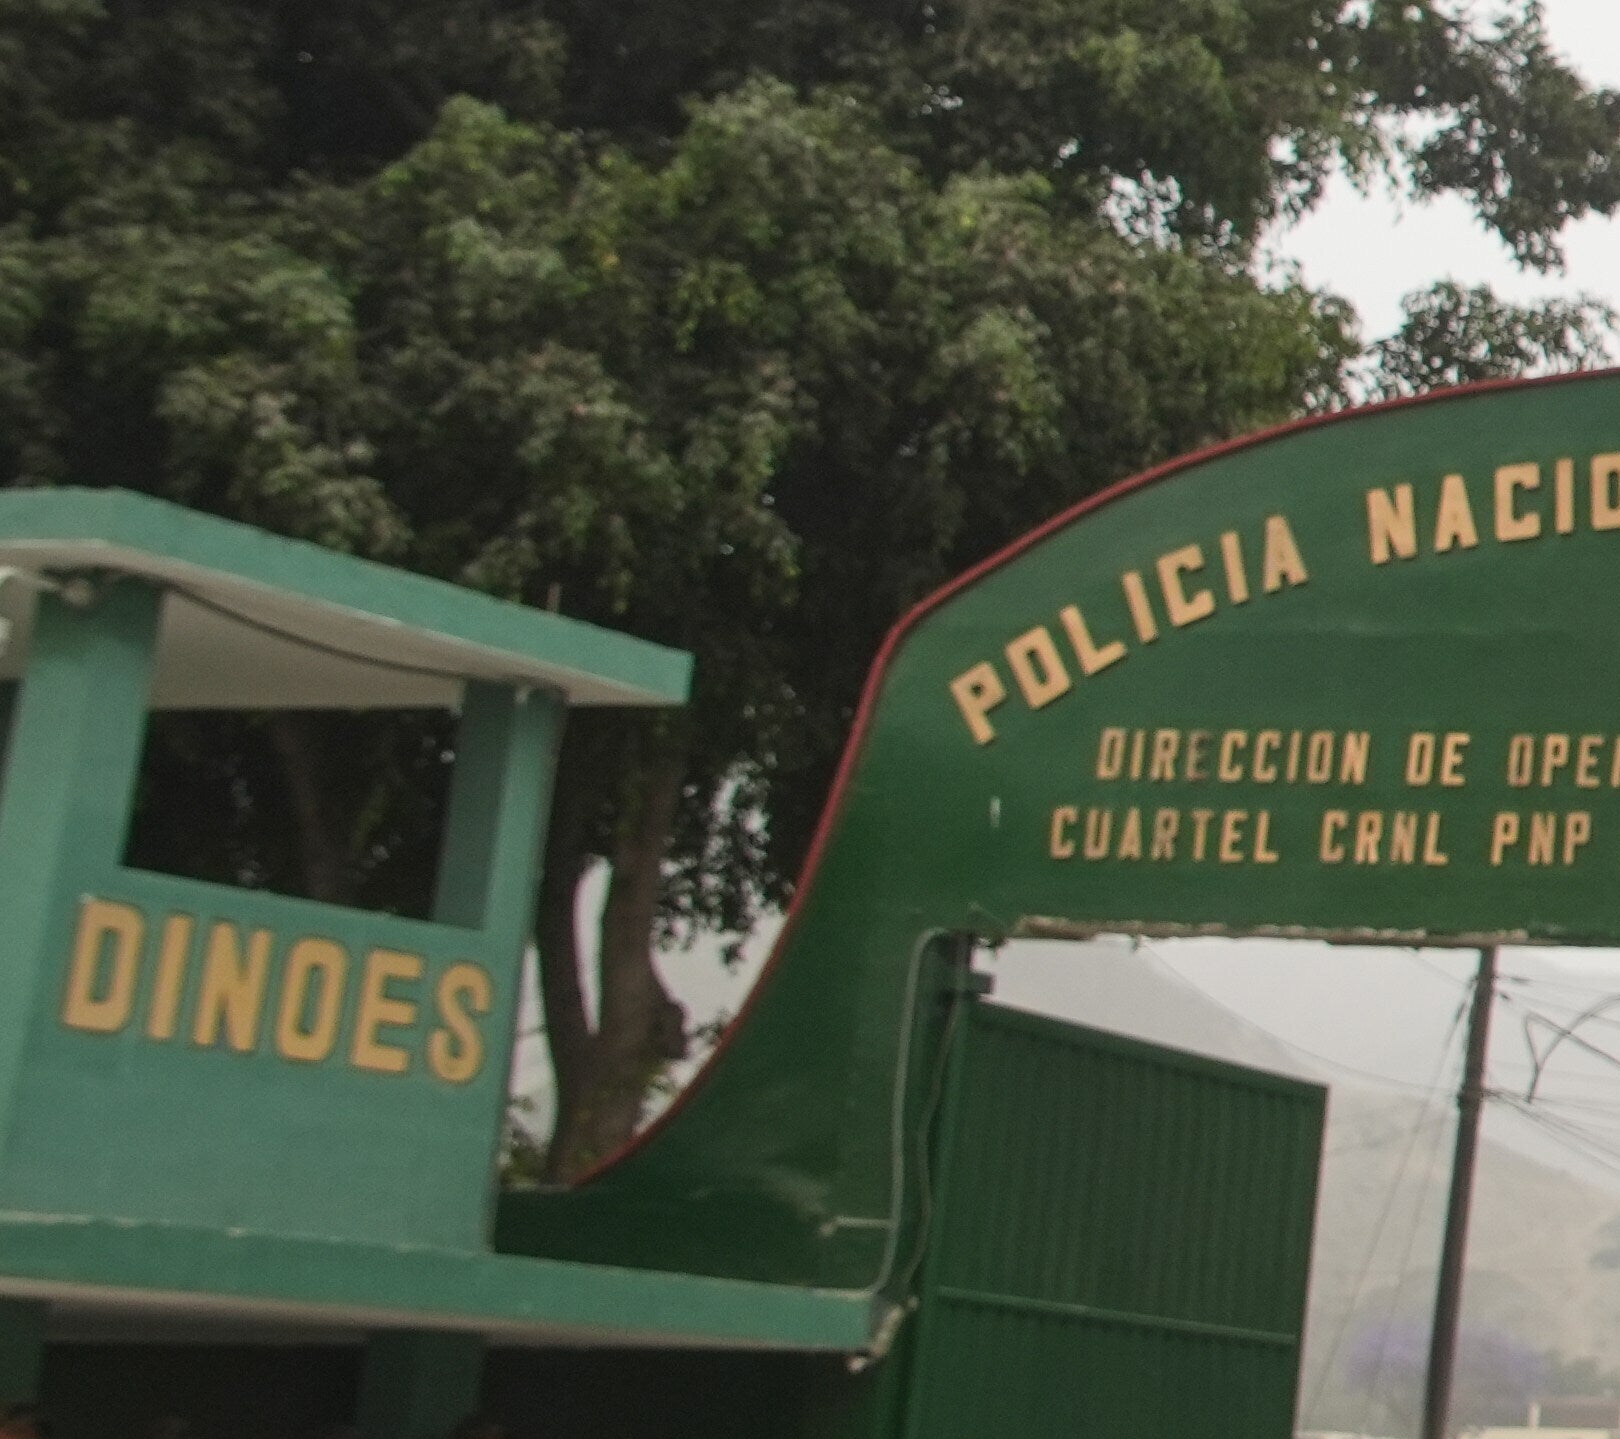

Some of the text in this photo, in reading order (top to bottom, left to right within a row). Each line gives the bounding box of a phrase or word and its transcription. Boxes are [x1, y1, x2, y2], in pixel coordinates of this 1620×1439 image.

[950, 515, 1306, 742] POLICIA
[1096, 729, 1369, 784] DIRECCION
[1405, 733, 1469, 786] DE
[1049, 807, 1279, 863] CUARTEL
[1319, 811, 1448, 867] CRNL
[1489, 812, 1589, 865] PNP
[63, 899, 492, 1084] DINOES
